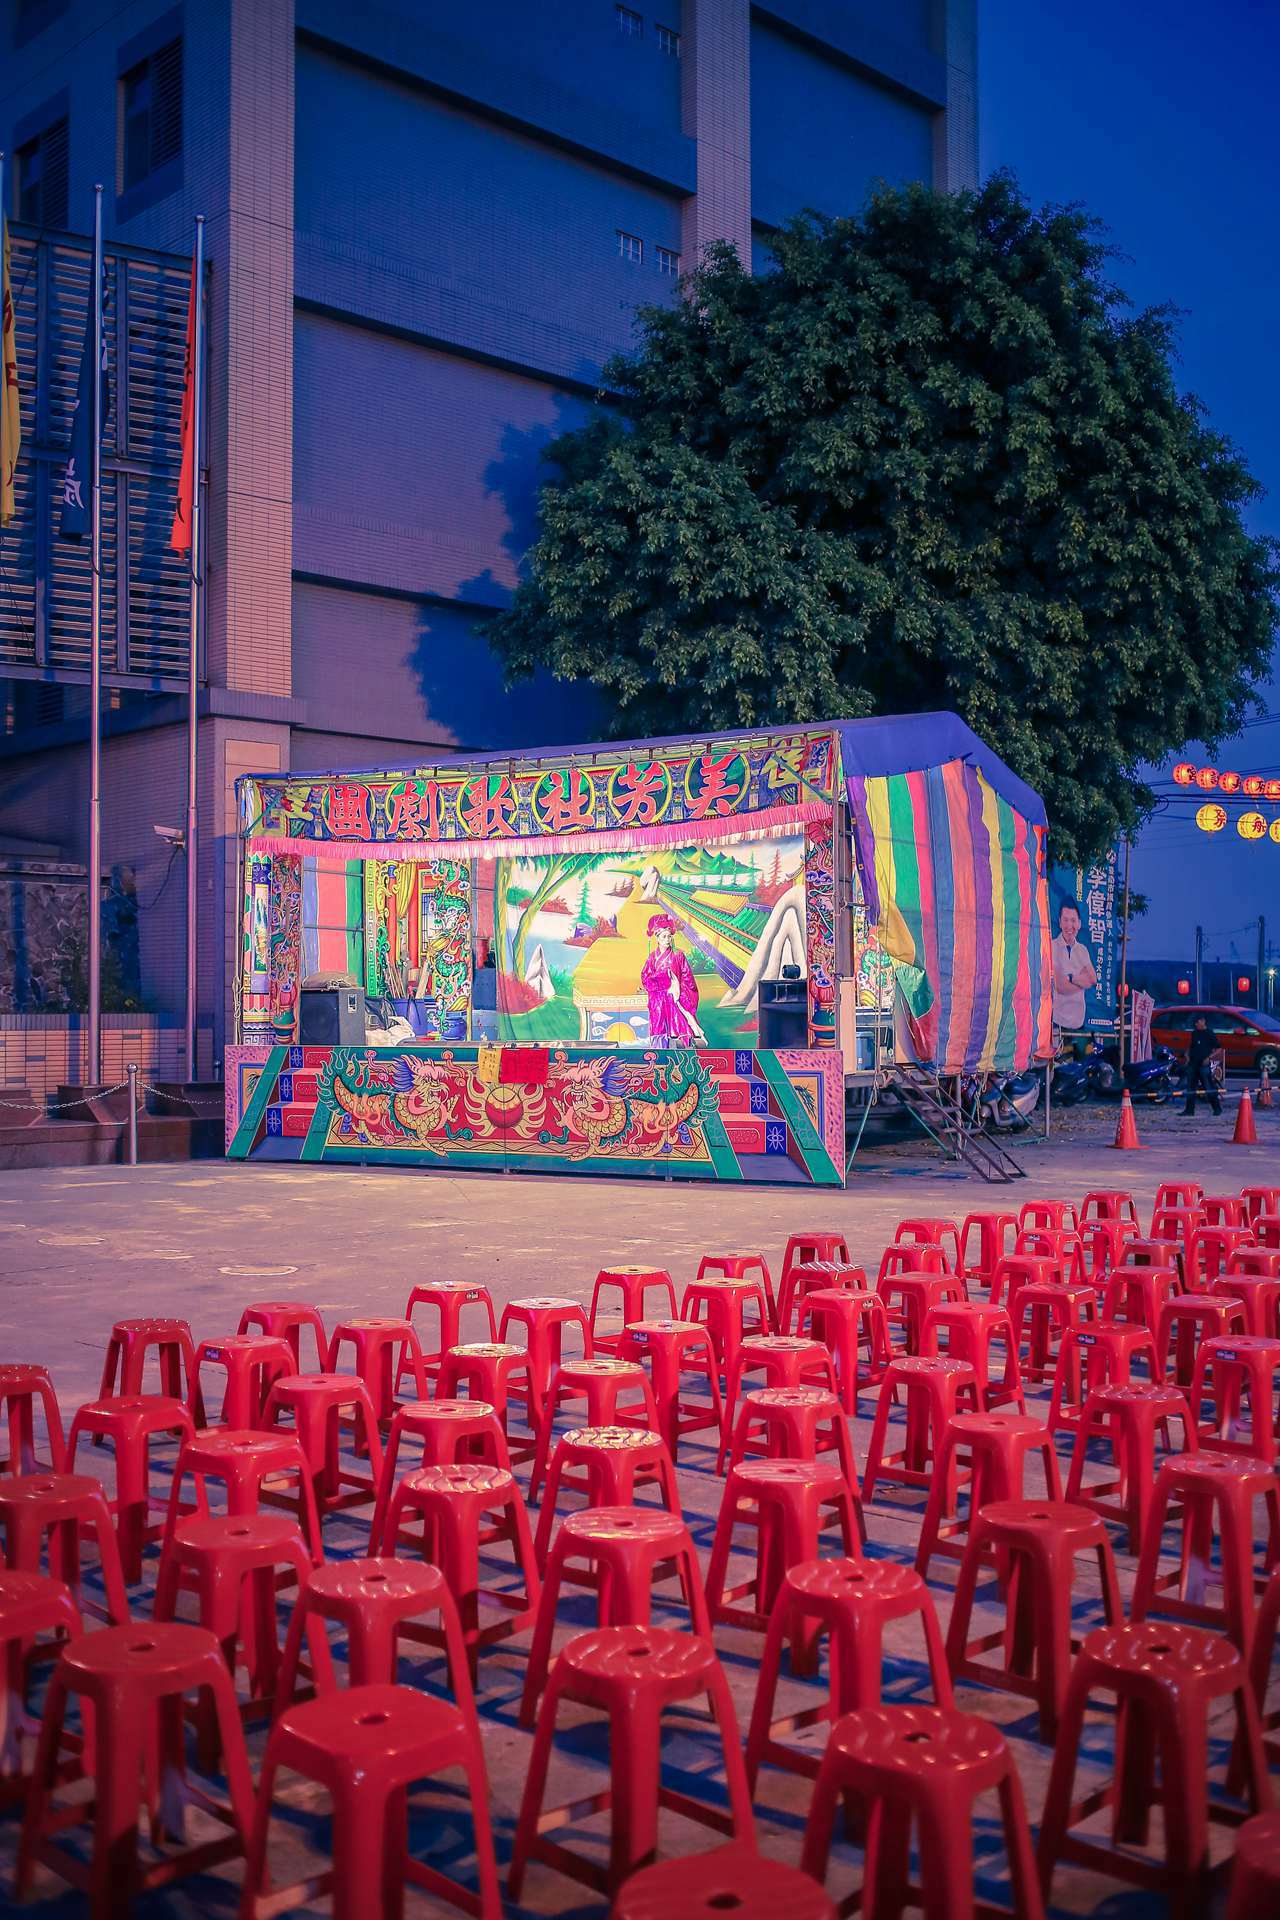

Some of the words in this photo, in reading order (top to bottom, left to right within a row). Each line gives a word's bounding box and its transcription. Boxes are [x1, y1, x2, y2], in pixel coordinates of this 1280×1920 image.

[328, 749, 740, 842] 美芳社歌劇團
